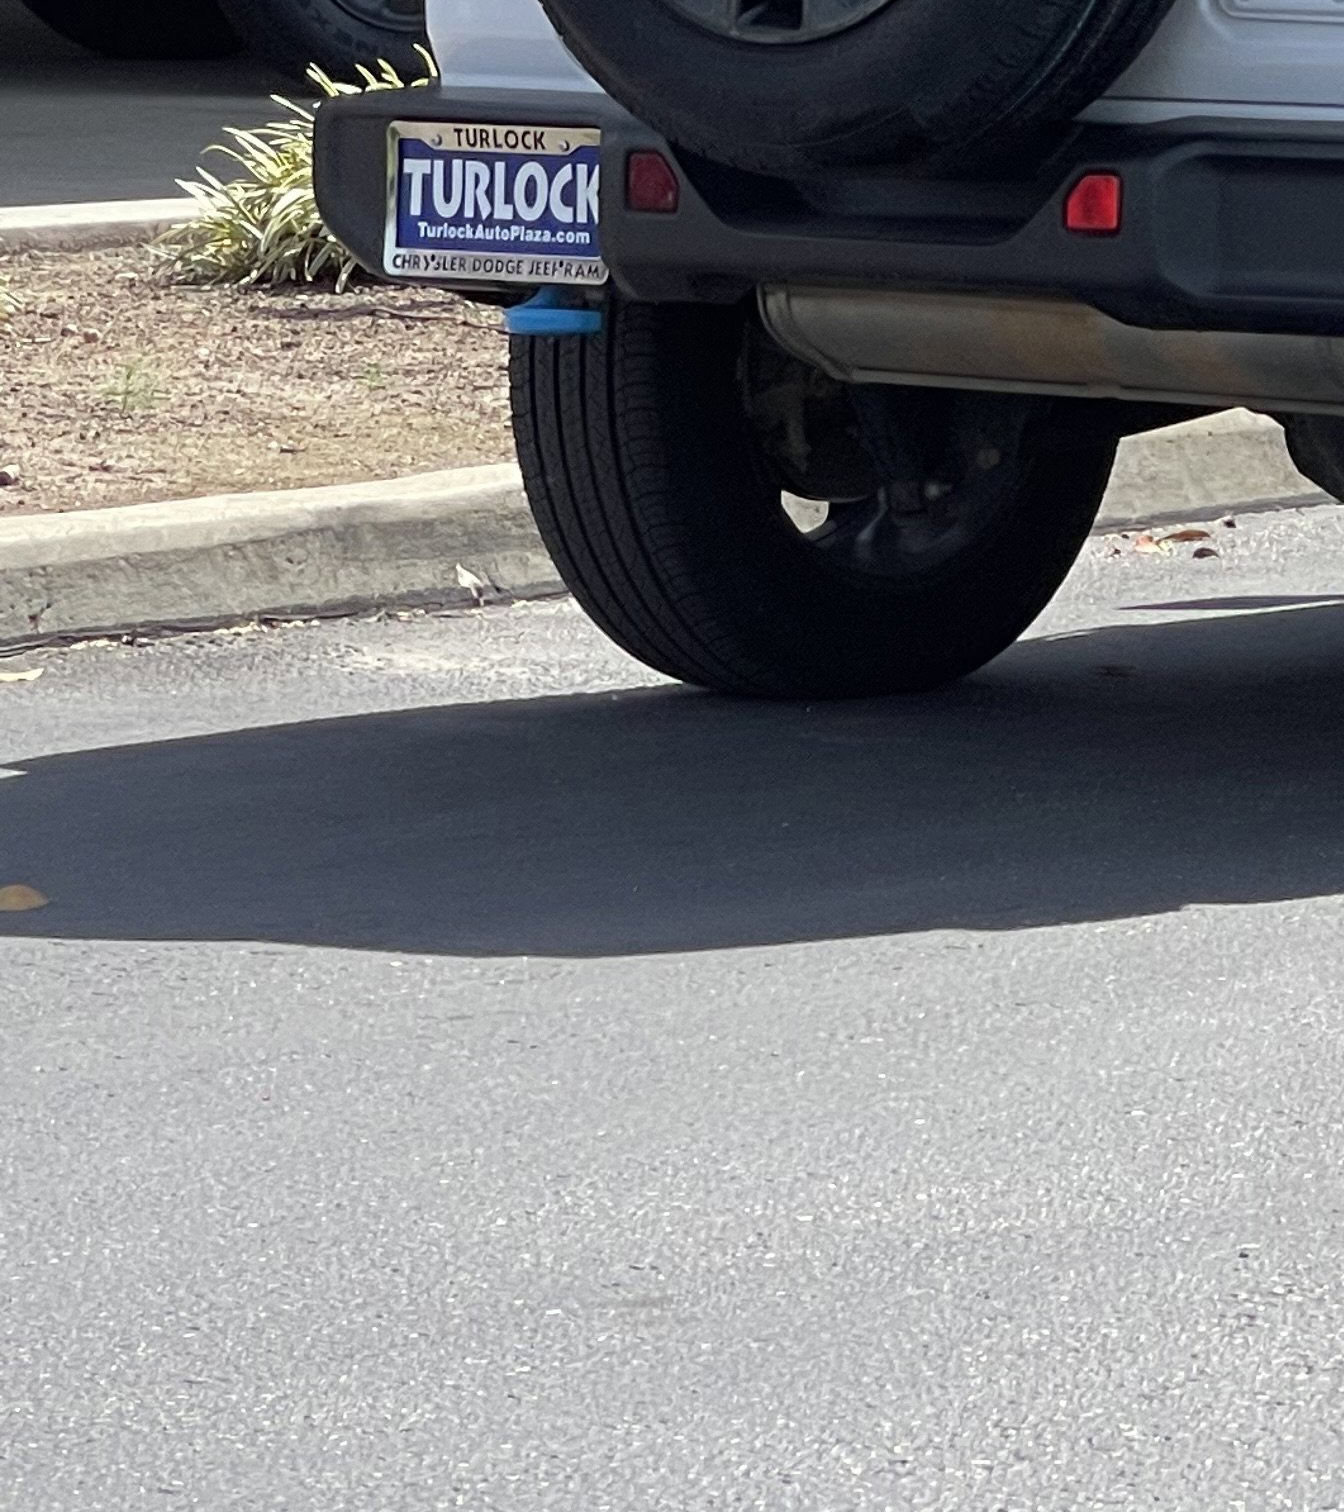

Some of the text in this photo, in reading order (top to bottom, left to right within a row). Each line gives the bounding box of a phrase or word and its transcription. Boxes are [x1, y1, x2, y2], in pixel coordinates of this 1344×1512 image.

[453, 128, 546, 150] TURLOCK
[403, 159, 599, 225] TURLOCK
[417, 221, 590, 244] TurlockAutoPlaza.com
[392, 253, 466, 272] CHRYSLER
[472, 258, 523, 275] DODGE
[564, 262, 600, 278] RAM
